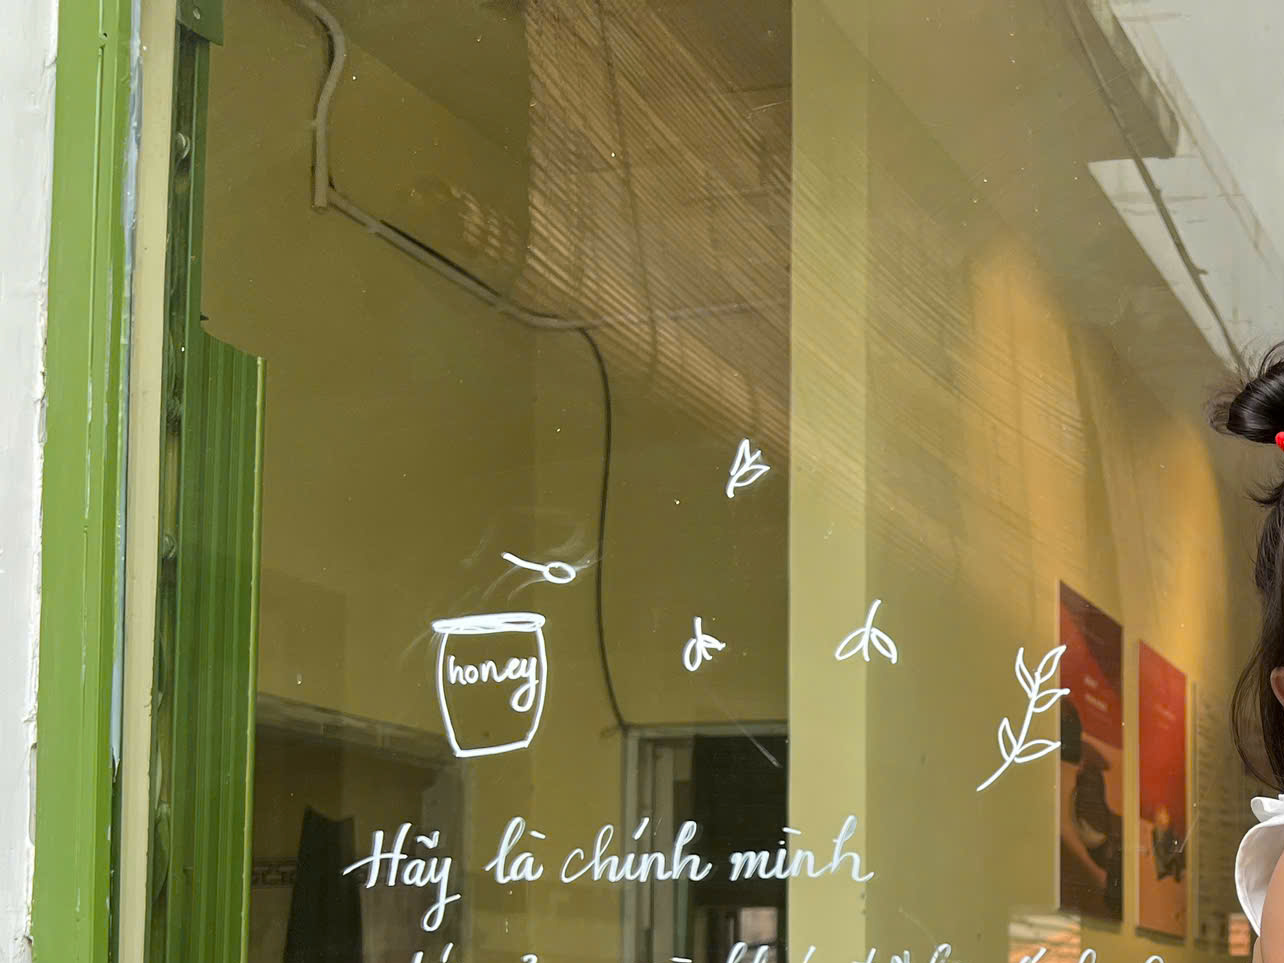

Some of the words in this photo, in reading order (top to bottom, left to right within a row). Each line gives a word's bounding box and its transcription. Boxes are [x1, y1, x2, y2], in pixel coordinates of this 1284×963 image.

[447, 655, 539, 712] honey
[342, 822, 461, 932] Hãy
[484, 816, 546, 884] là
[560, 817, 711, 883] chính
[729, 815, 876, 882] mình
